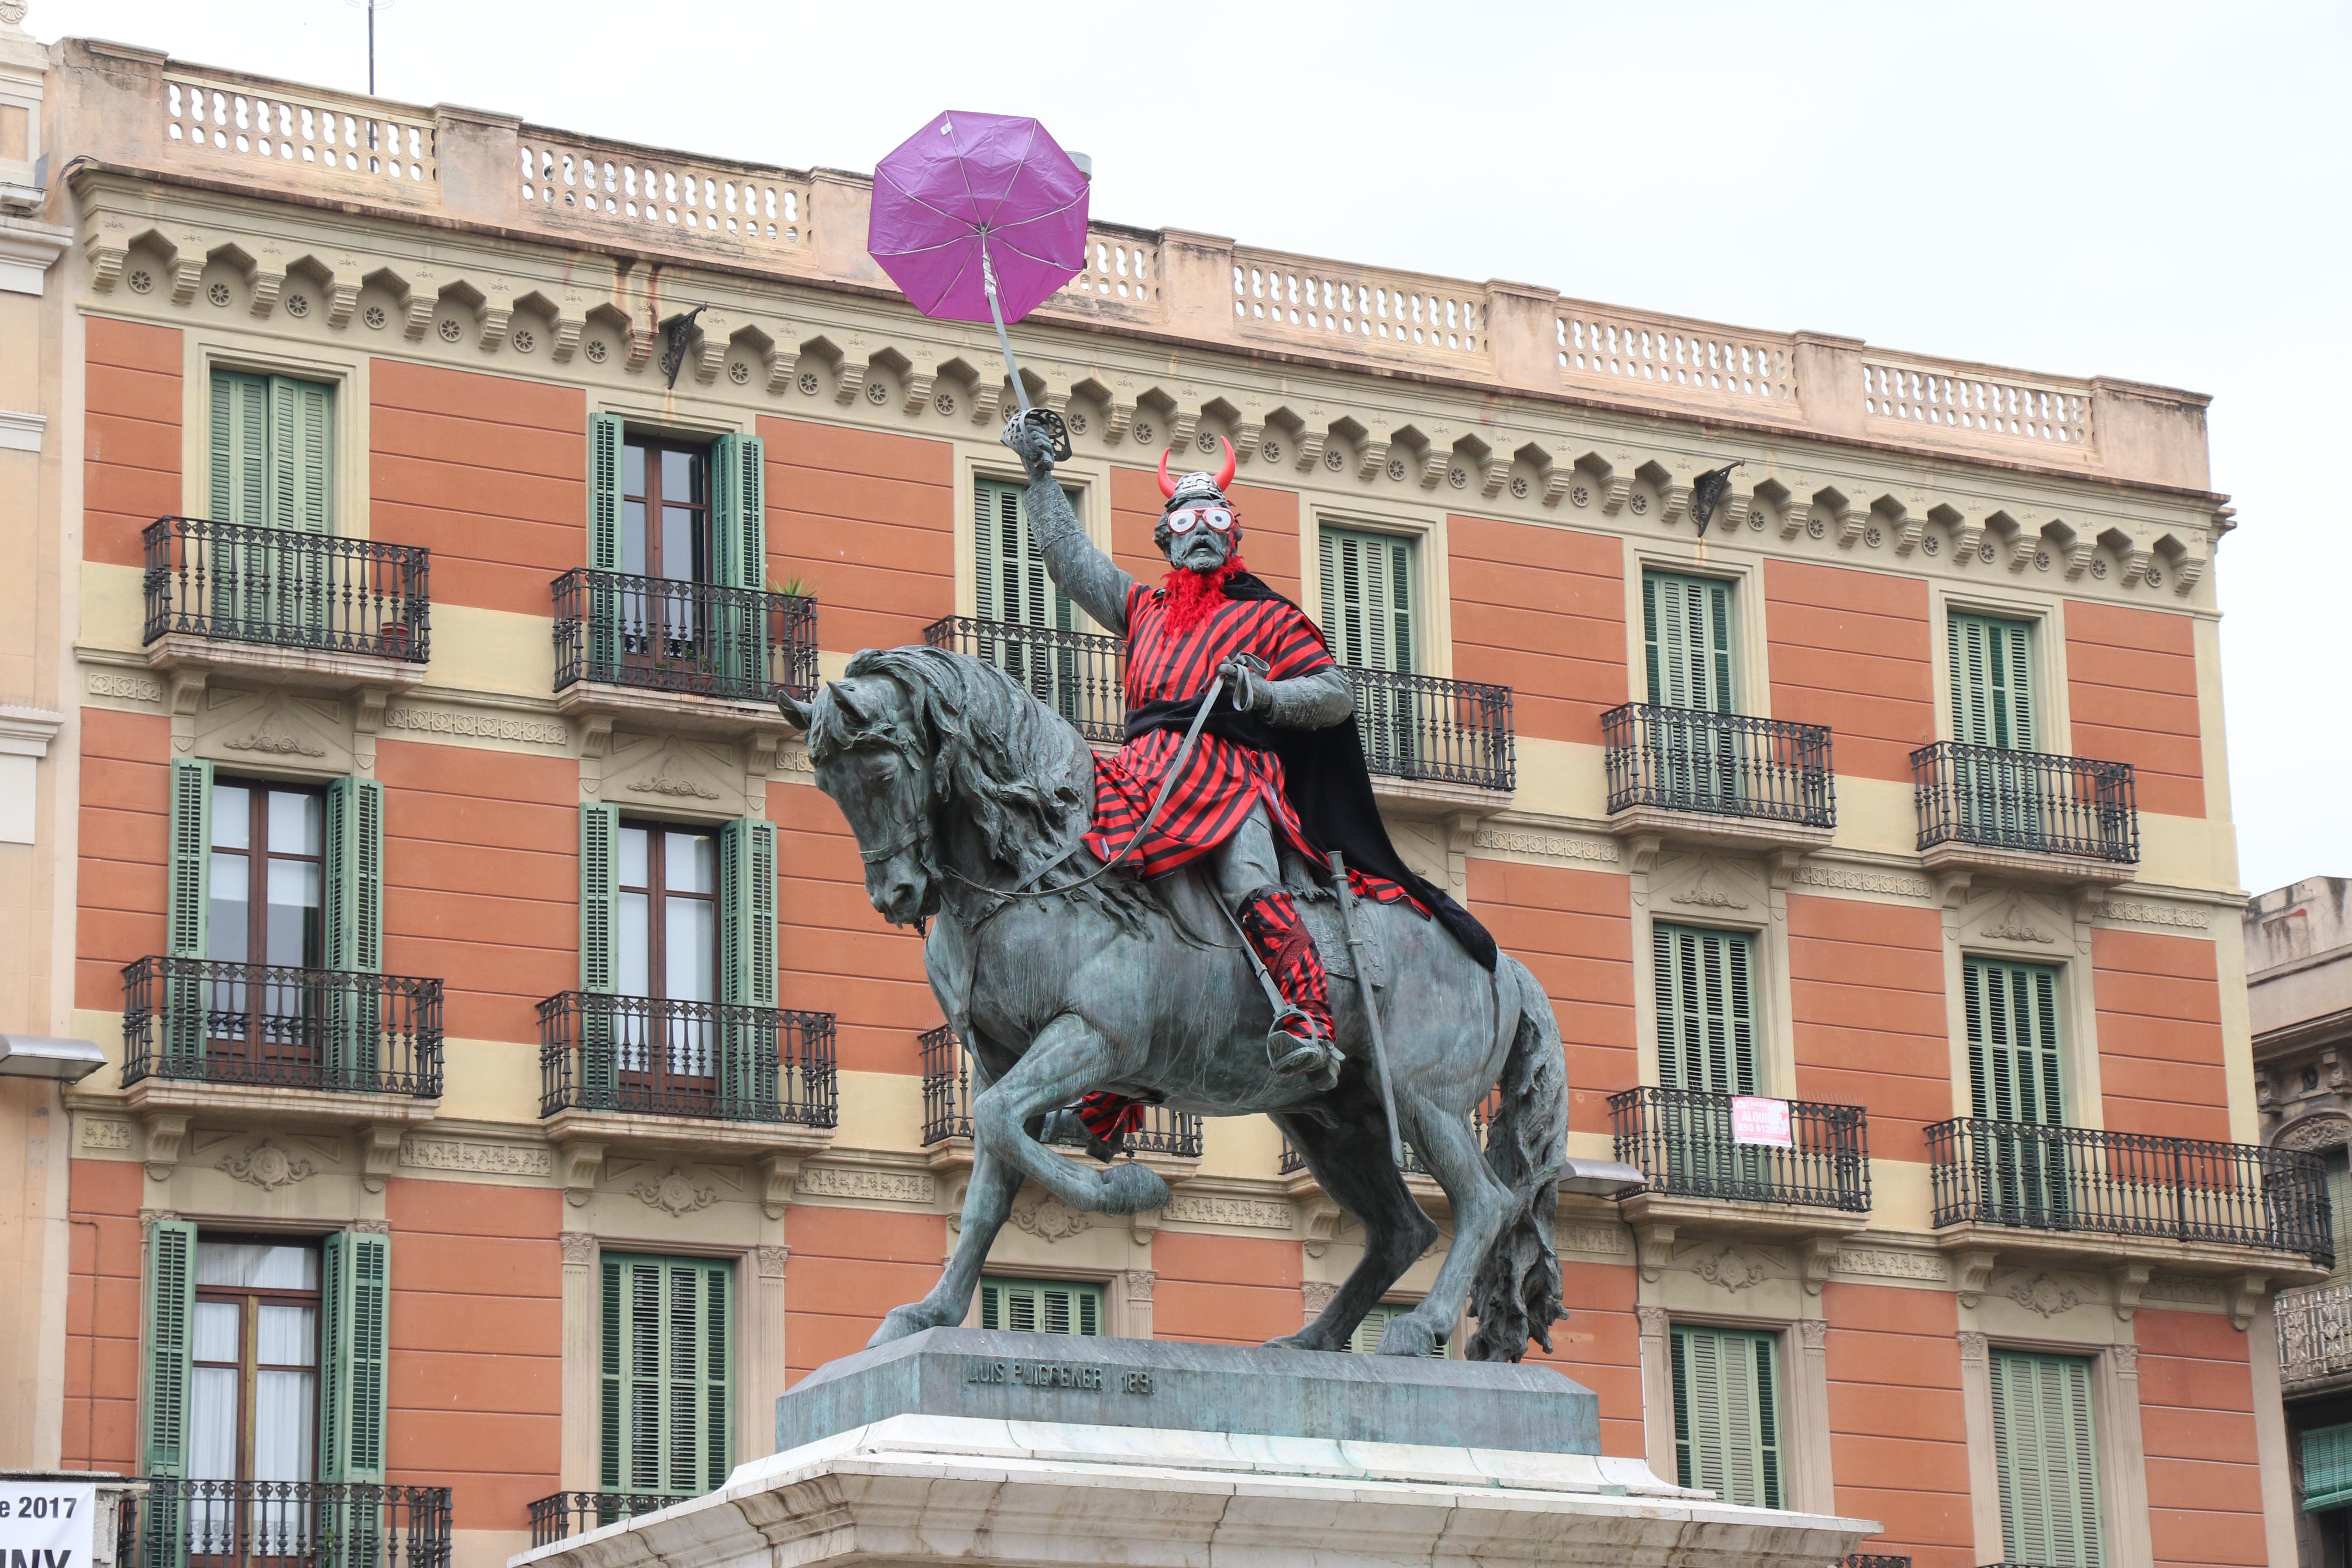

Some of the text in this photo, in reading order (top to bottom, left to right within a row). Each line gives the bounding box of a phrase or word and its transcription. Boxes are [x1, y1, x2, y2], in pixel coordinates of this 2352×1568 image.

[1738, 1123, 1754, 1132] 650
[967, 1360, 1005, 1383] LUIS
[1121, 1370, 1155, 1393] 1891
[18, 1497, 77, 1519] 2017
